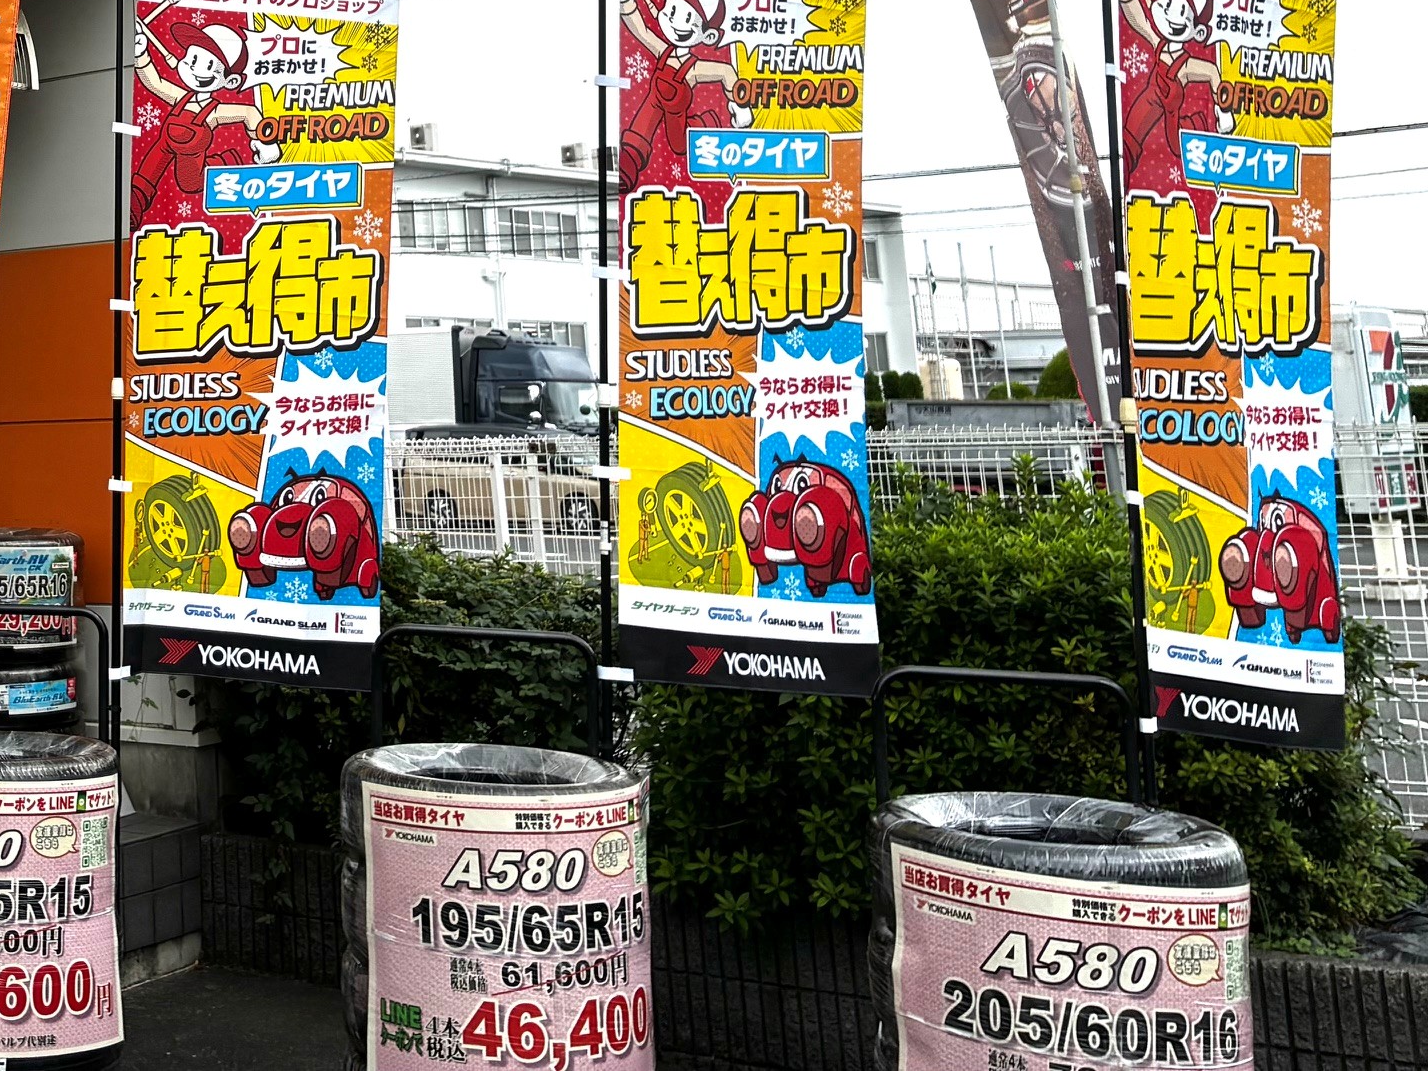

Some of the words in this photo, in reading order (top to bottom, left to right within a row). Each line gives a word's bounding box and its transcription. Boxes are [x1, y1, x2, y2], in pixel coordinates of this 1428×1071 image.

[261, 36, 316, 55] プロに
[757, 44, 863, 74] PREMIUM
[1240, 45, 1332, 83] PREMIUM
[285, 80, 393, 110] PREMIUM
[695, 135, 818, 168] 冬のタイヤ
[1185, 138, 1288, 181] 冬のタイヤ
[213, 170, 351, 201] 冬のタイヤ
[630, 192, 846, 326] 替え得市
[1127, 196, 1314, 344] 替え得市
[134, 220, 375, 352] 替え得市
[625, 349, 733, 380] STUDLESS
[129, 372, 240, 402] STUDLESS
[759, 375, 852, 396] 今ならお得に
[275, 393, 375, 413] 今ならお得に
[650, 385, 755, 419] ECOLOGY
[1246, 404, 1322, 426] 今ならお得に
[143, 404, 269, 436] ECOLOGY
[1138, 408, 1244, 443] COLOGY
[129, 602, 174, 612] タイヤガーデン
[257, 616, 296, 627] GRAND
[297, 620, 327, 629] SLAM
[631, 601, 699, 615] タイヤガーデン
[198, 643, 320, 675] YOKOHAMA
[723, 651, 825, 680] YOKOHAMA
[1180, 692, 1299, 733] YOKOHAMA
[49, 796, 75, 810] LINE
[374, 800, 465, 826] 当店お買得タイヤ
[553, 809, 605, 830] クーポンを
[606, 806, 627, 824] LINE
[395, 831, 435, 844] YOKOHAMA
[442, 847, 586, 892] A580
[904, 865, 1011, 906] 当店お買得タイヤ
[412, 890, 644, 953] 195/65R15
[927, 902, 974, 921] YOKOHAMA
[1118, 904, 1185, 926] クーポンを
[1188, 908, 1217, 926] LINE
[500, 952, 628, 994] 61,600円
[981, 929, 1162, 995] A580
[380, 997, 423, 1030] LINE
[941, 978, 1241, 1067] 205/60R16
[427, 1036, 468, 1062] 税込
